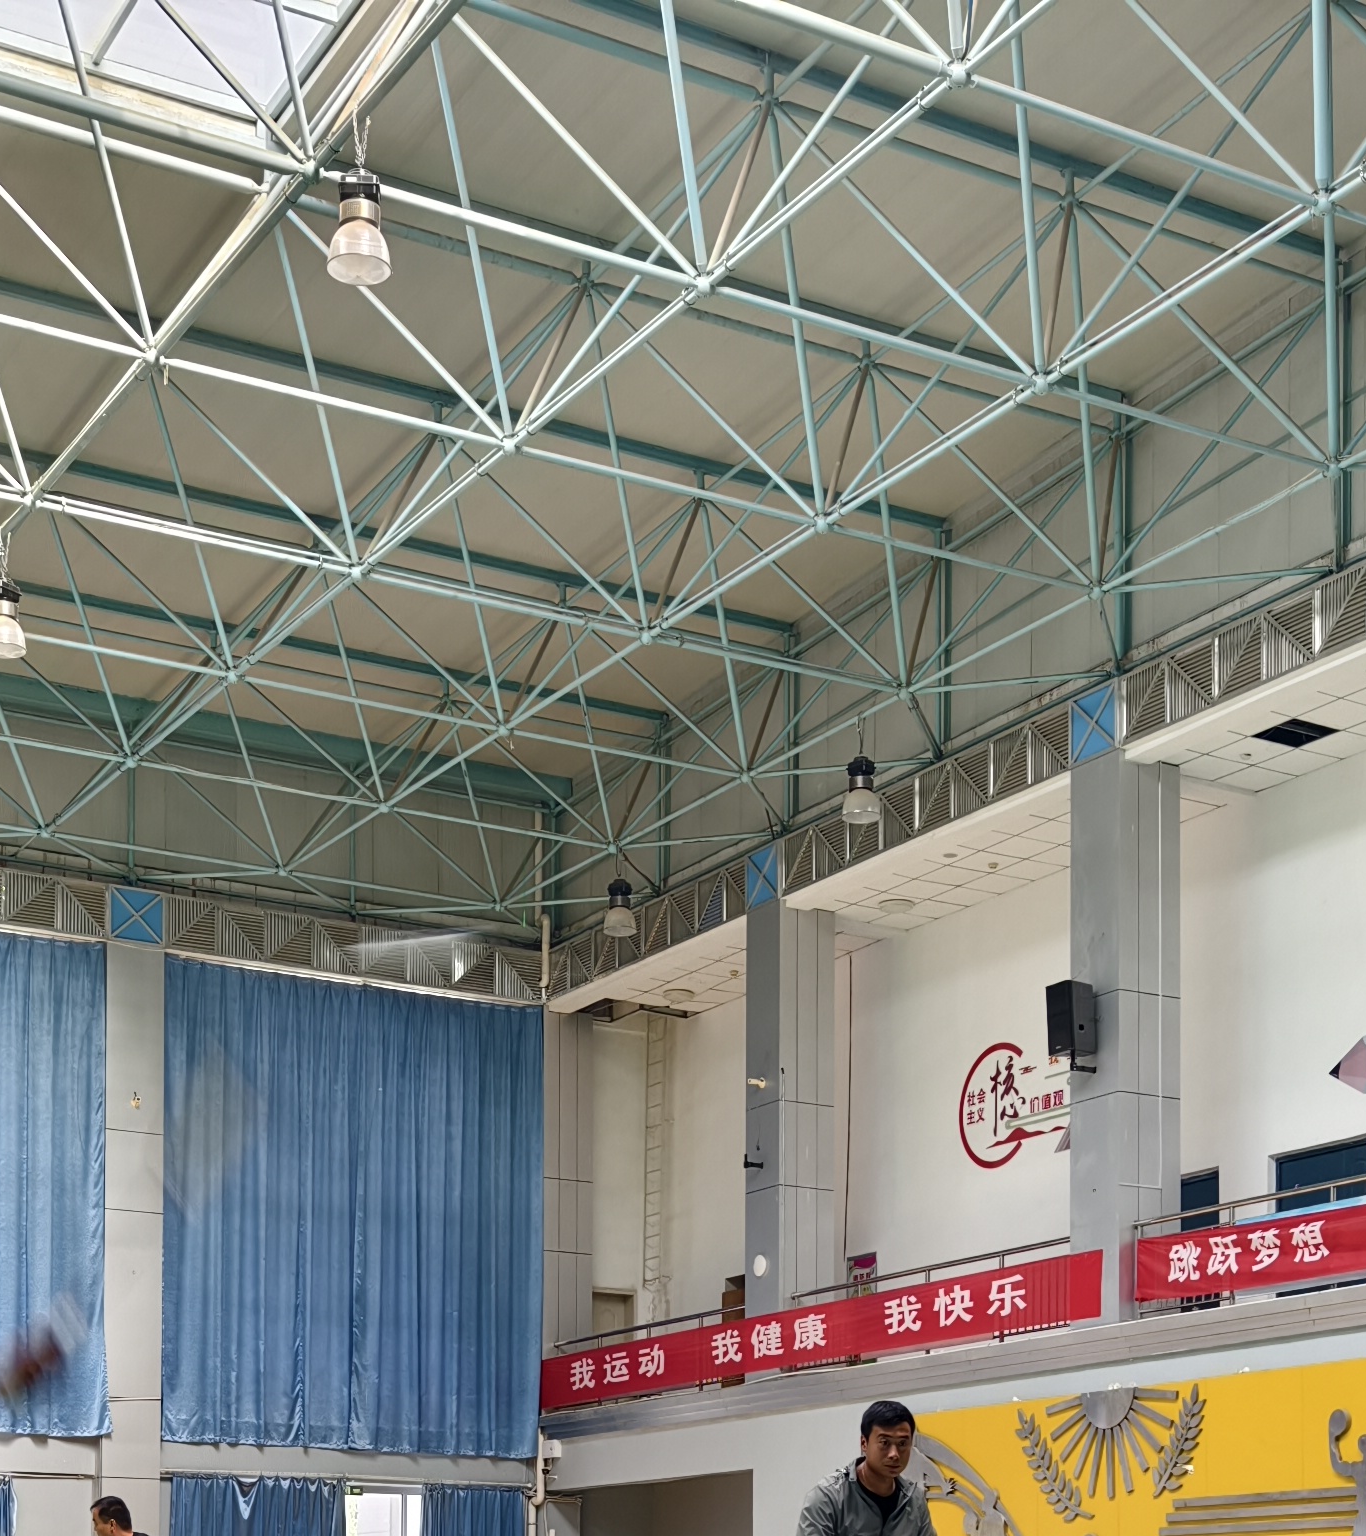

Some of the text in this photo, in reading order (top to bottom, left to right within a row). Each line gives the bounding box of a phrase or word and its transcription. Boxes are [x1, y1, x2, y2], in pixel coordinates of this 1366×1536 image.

[1030, 1089, 1064, 1114] 价值观
[1167, 1219, 1331, 1284] 跳跃梦想
[569, 1274, 1028, 1391] 我运动 我健康 我快乐
